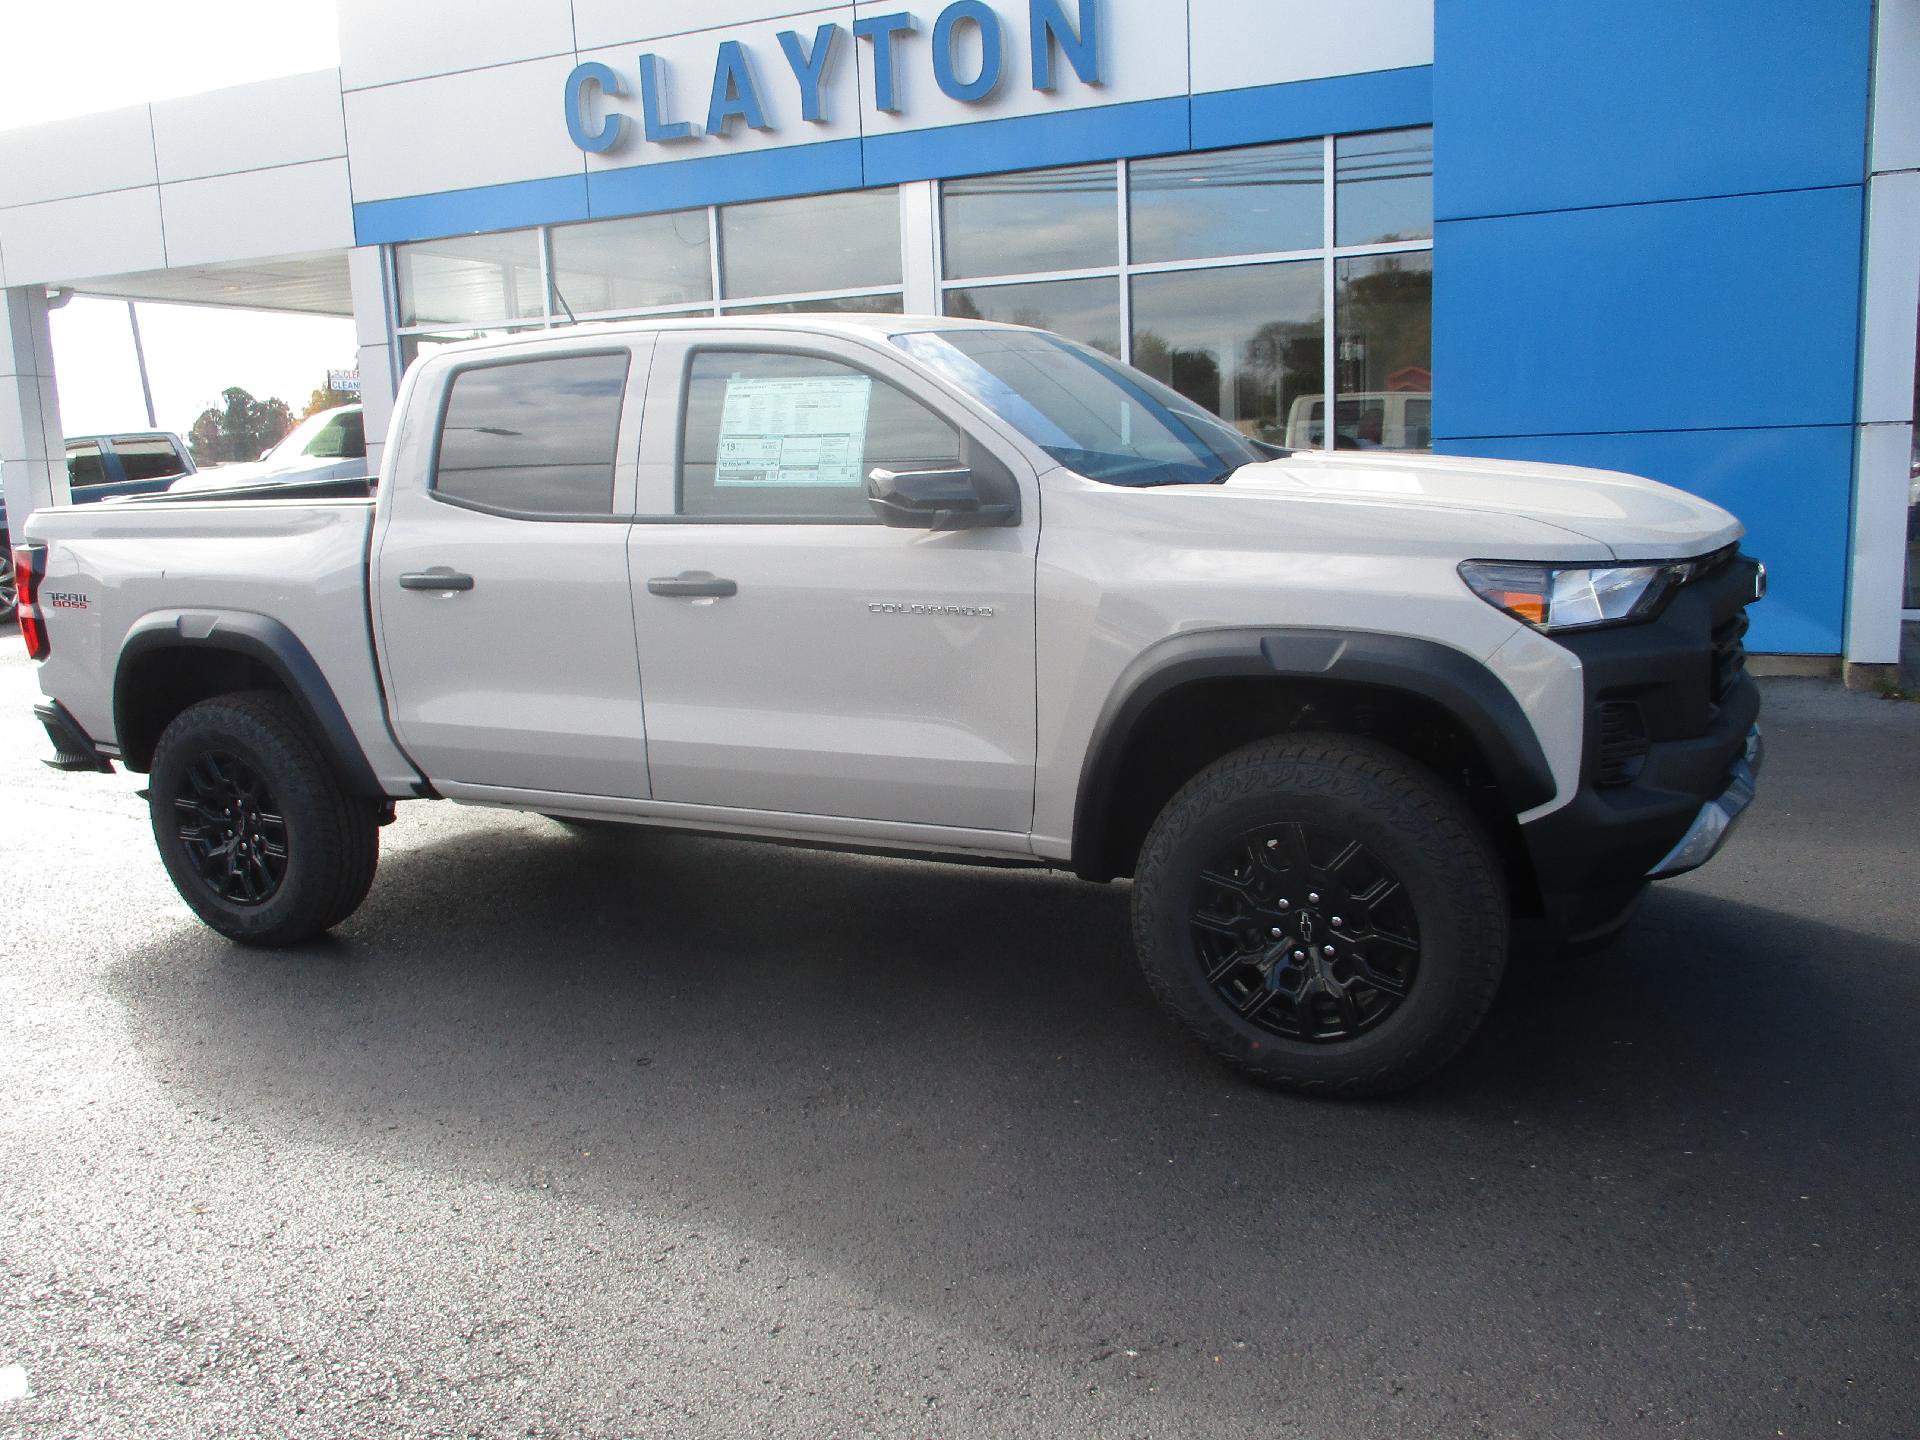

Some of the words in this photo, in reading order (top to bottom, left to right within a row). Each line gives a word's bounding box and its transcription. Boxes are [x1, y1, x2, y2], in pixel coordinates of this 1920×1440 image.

[564, 0, 1105, 155] CLAYTON
[45, 592, 92, 602] TRAIL
[52, 601, 88, 609] BOSS
[868, 603, 993, 617] COLORADO
